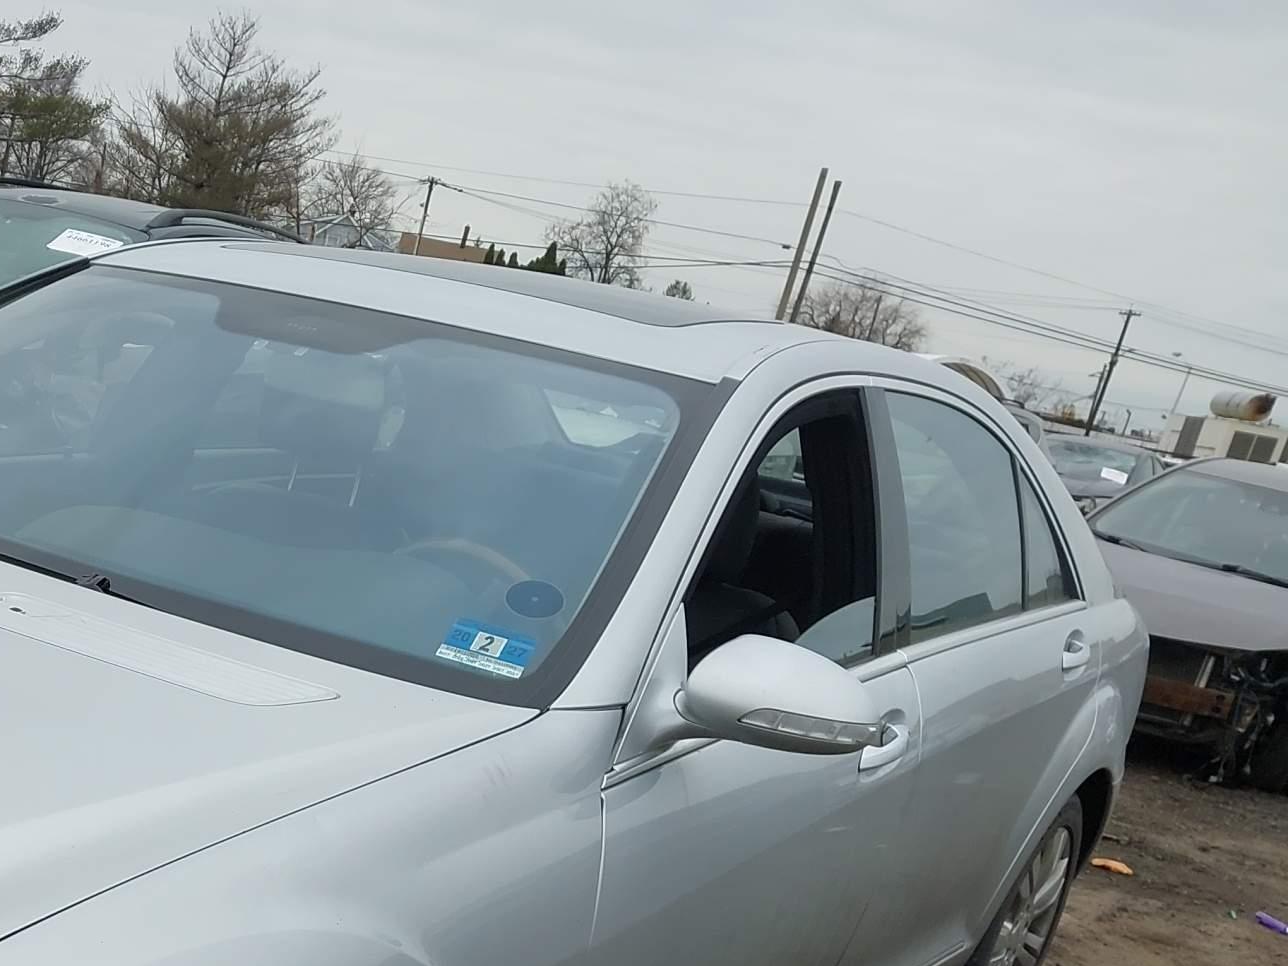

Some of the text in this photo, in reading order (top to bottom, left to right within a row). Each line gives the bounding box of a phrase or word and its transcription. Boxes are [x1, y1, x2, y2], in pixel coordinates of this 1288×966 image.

[453, 629, 471, 642] 20
[478, 635, 495, 652] 2
[506, 646, 528, 658] 27
